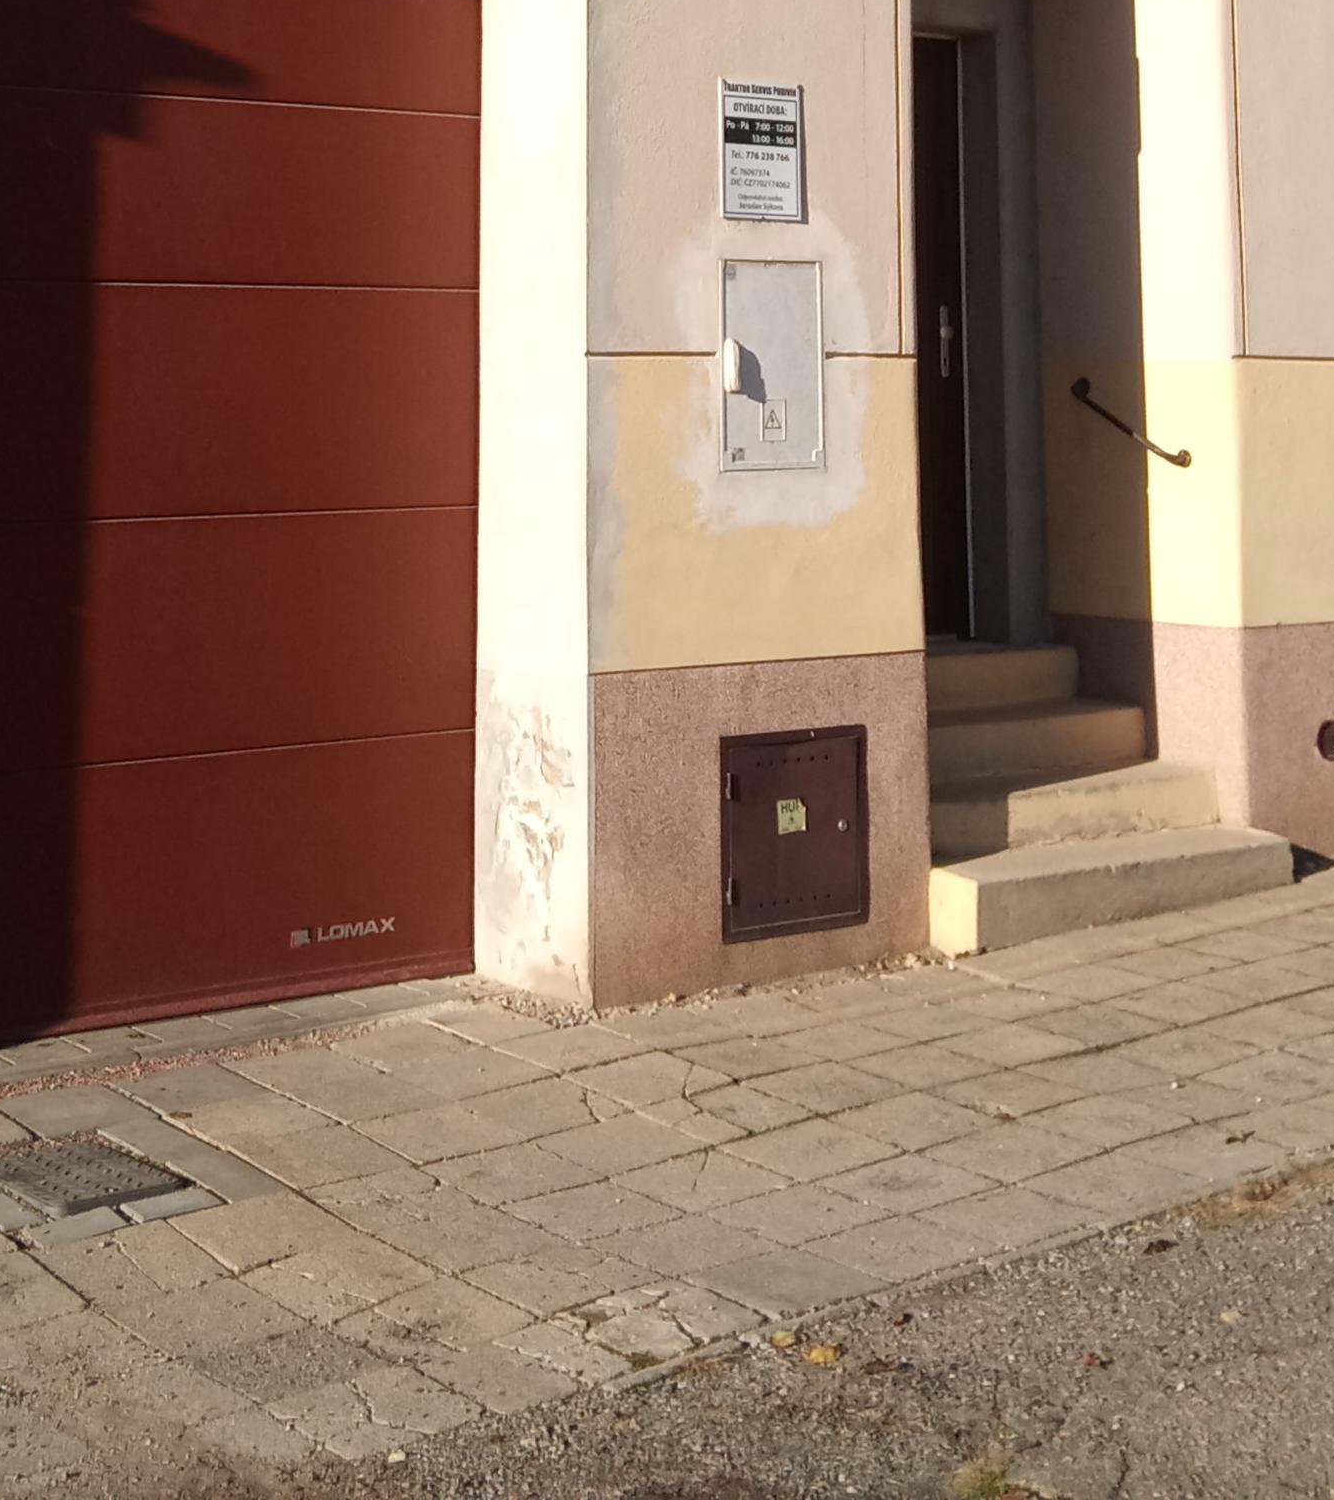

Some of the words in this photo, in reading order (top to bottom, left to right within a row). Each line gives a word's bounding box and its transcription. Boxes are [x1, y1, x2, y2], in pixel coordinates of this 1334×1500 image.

[751, 84, 772, 96] SERVIS
[733, 101, 765, 115] OTVÍRACÍ
[726, 120, 735, 130] Po
[755, 122, 770, 132] 7:00
[776, 123, 794, 133] 12:00
[776, 135, 794, 145] 16:00
[746, 151, 759, 161] 776
[760, 152, 774, 161] 238
[776, 152, 790, 162] 766
[318, 917, 395, 942] LOMAX
